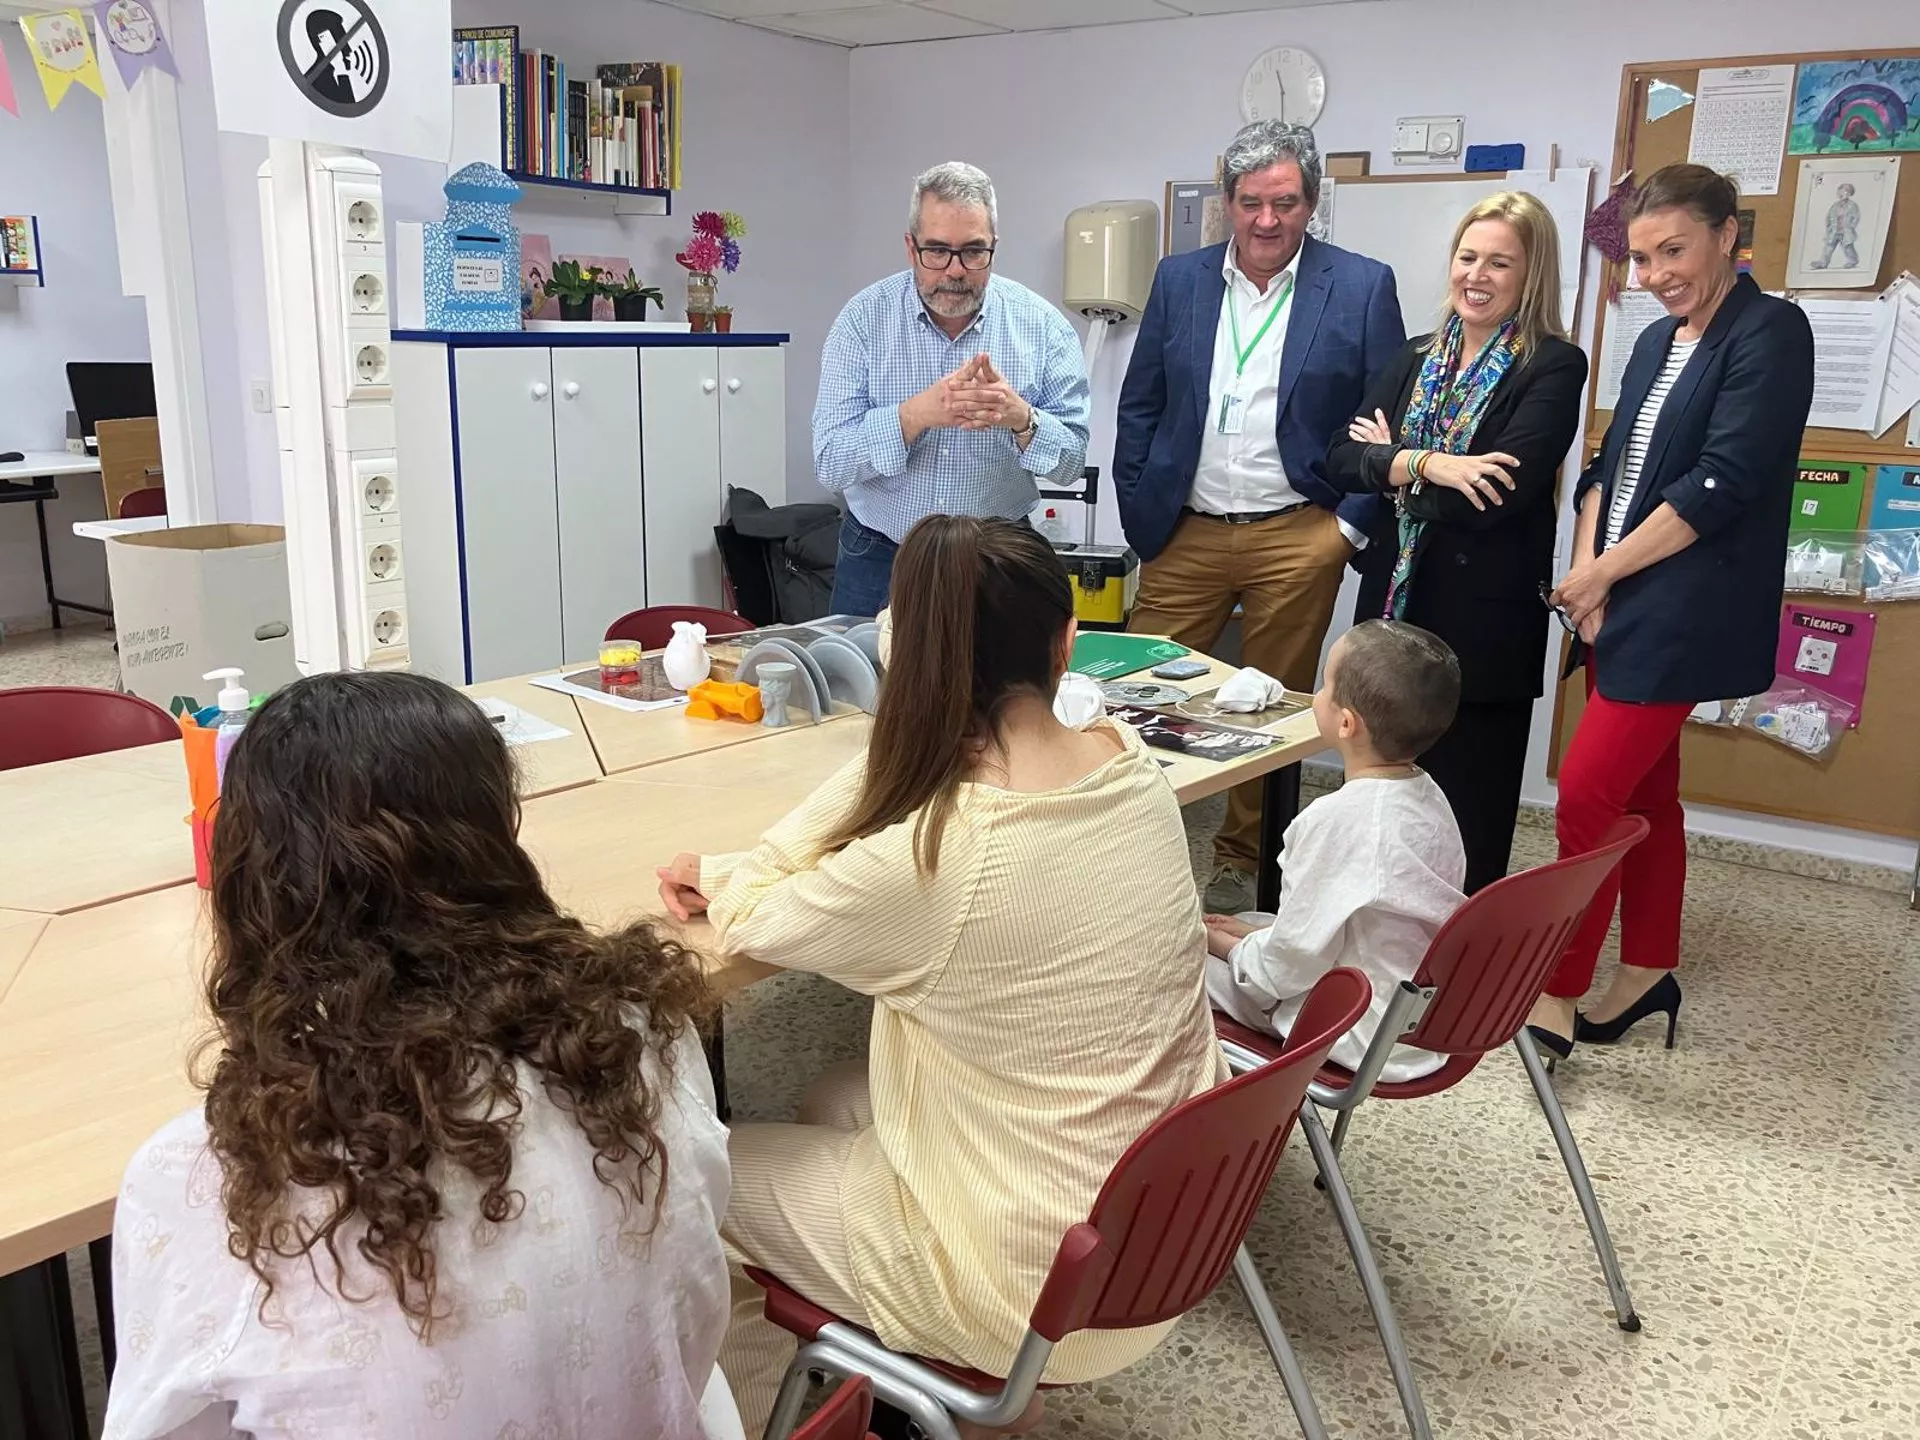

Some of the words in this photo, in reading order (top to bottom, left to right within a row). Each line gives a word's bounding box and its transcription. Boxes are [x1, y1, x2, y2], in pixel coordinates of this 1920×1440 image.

[1277, 49, 1291, 63] 12
[1249, 71, 1263, 85] 10
[1250, 106, 1259, 120] 8
[1799, 470, 1840, 482] FECHA
[1804, 502, 1816, 511] 17
[1801, 616, 1847, 633] TIEMPO
